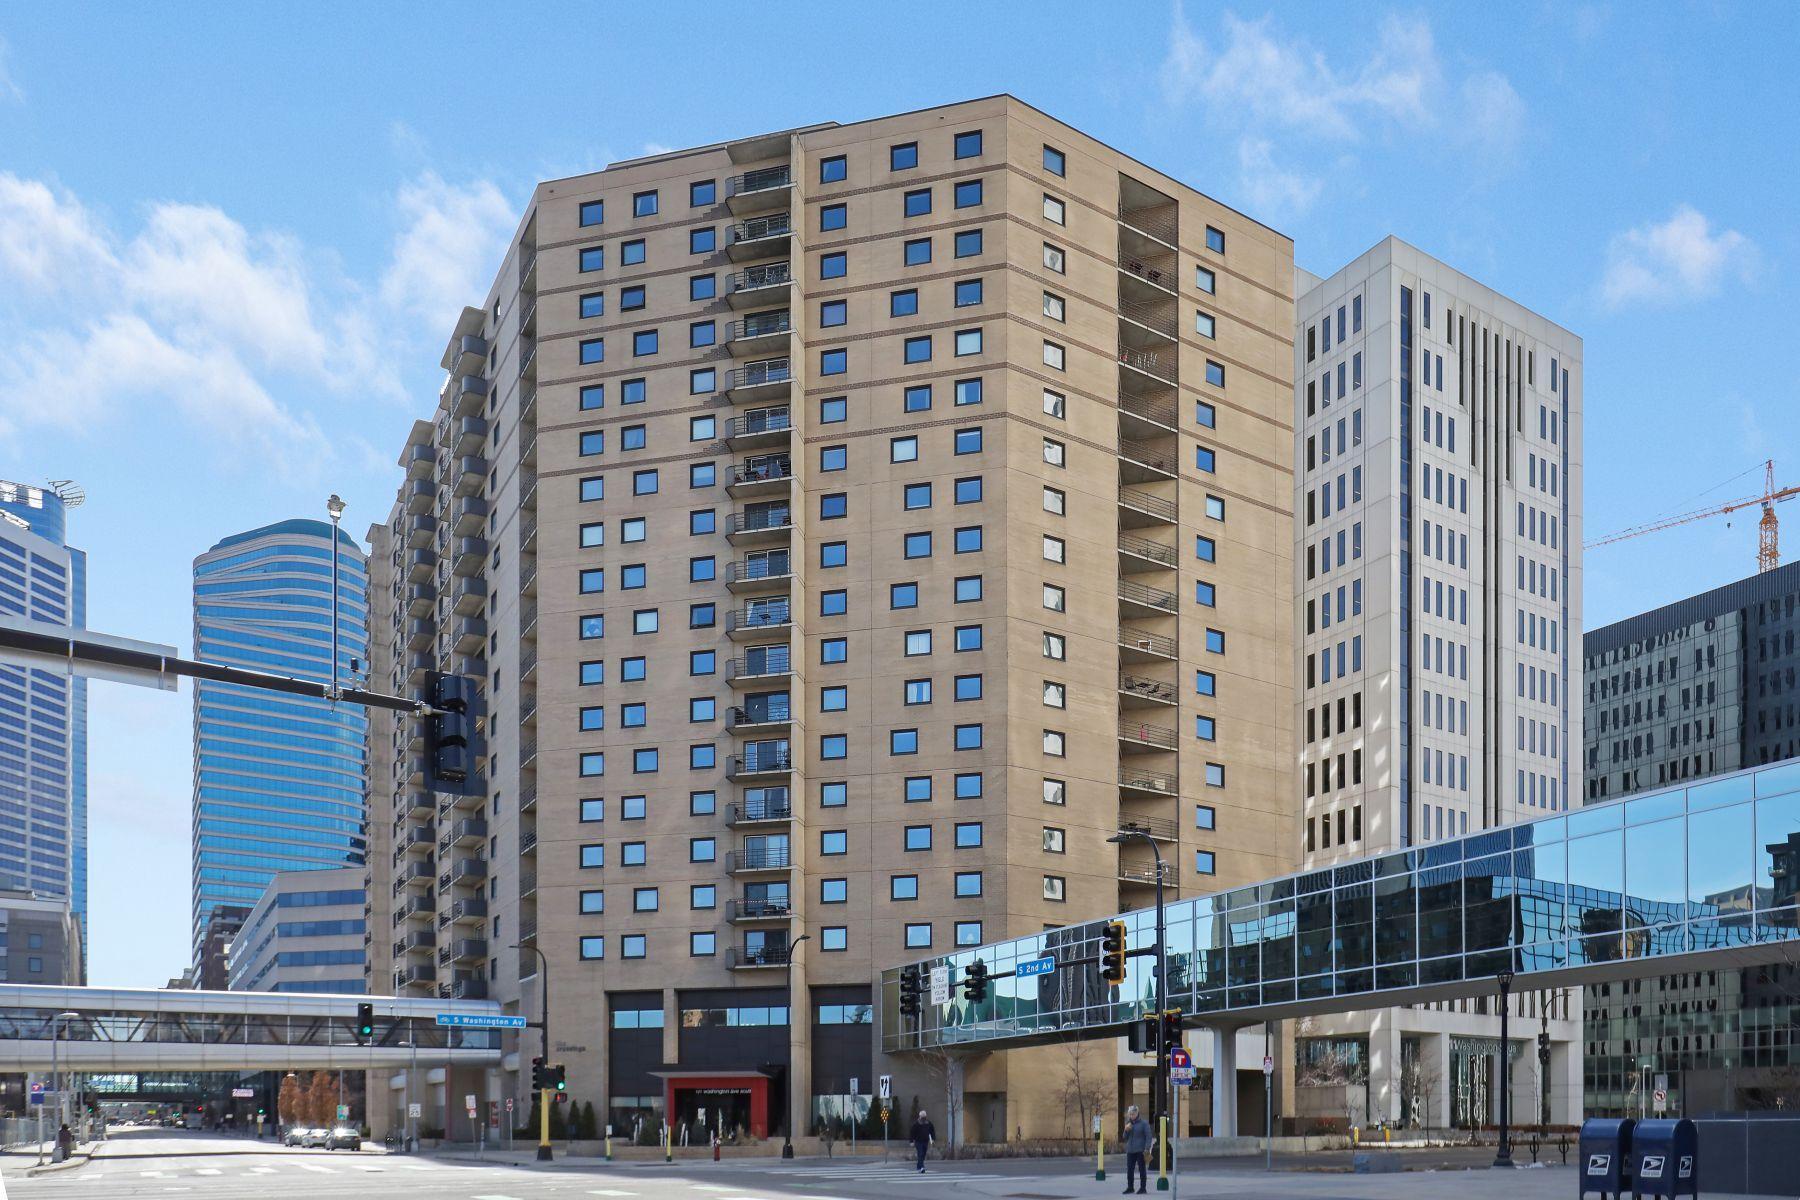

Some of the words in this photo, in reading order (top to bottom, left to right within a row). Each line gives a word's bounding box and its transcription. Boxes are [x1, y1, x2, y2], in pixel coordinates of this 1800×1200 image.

[1018, 966, 1023, 974] S
[1026, 964, 1038, 972] 2nd
[1042, 961, 1052, 970] Av
[453, 1016, 459, 1024] S
[462, 1017, 509, 1026] Washington
[1175, 1054, 1186, 1066] T
